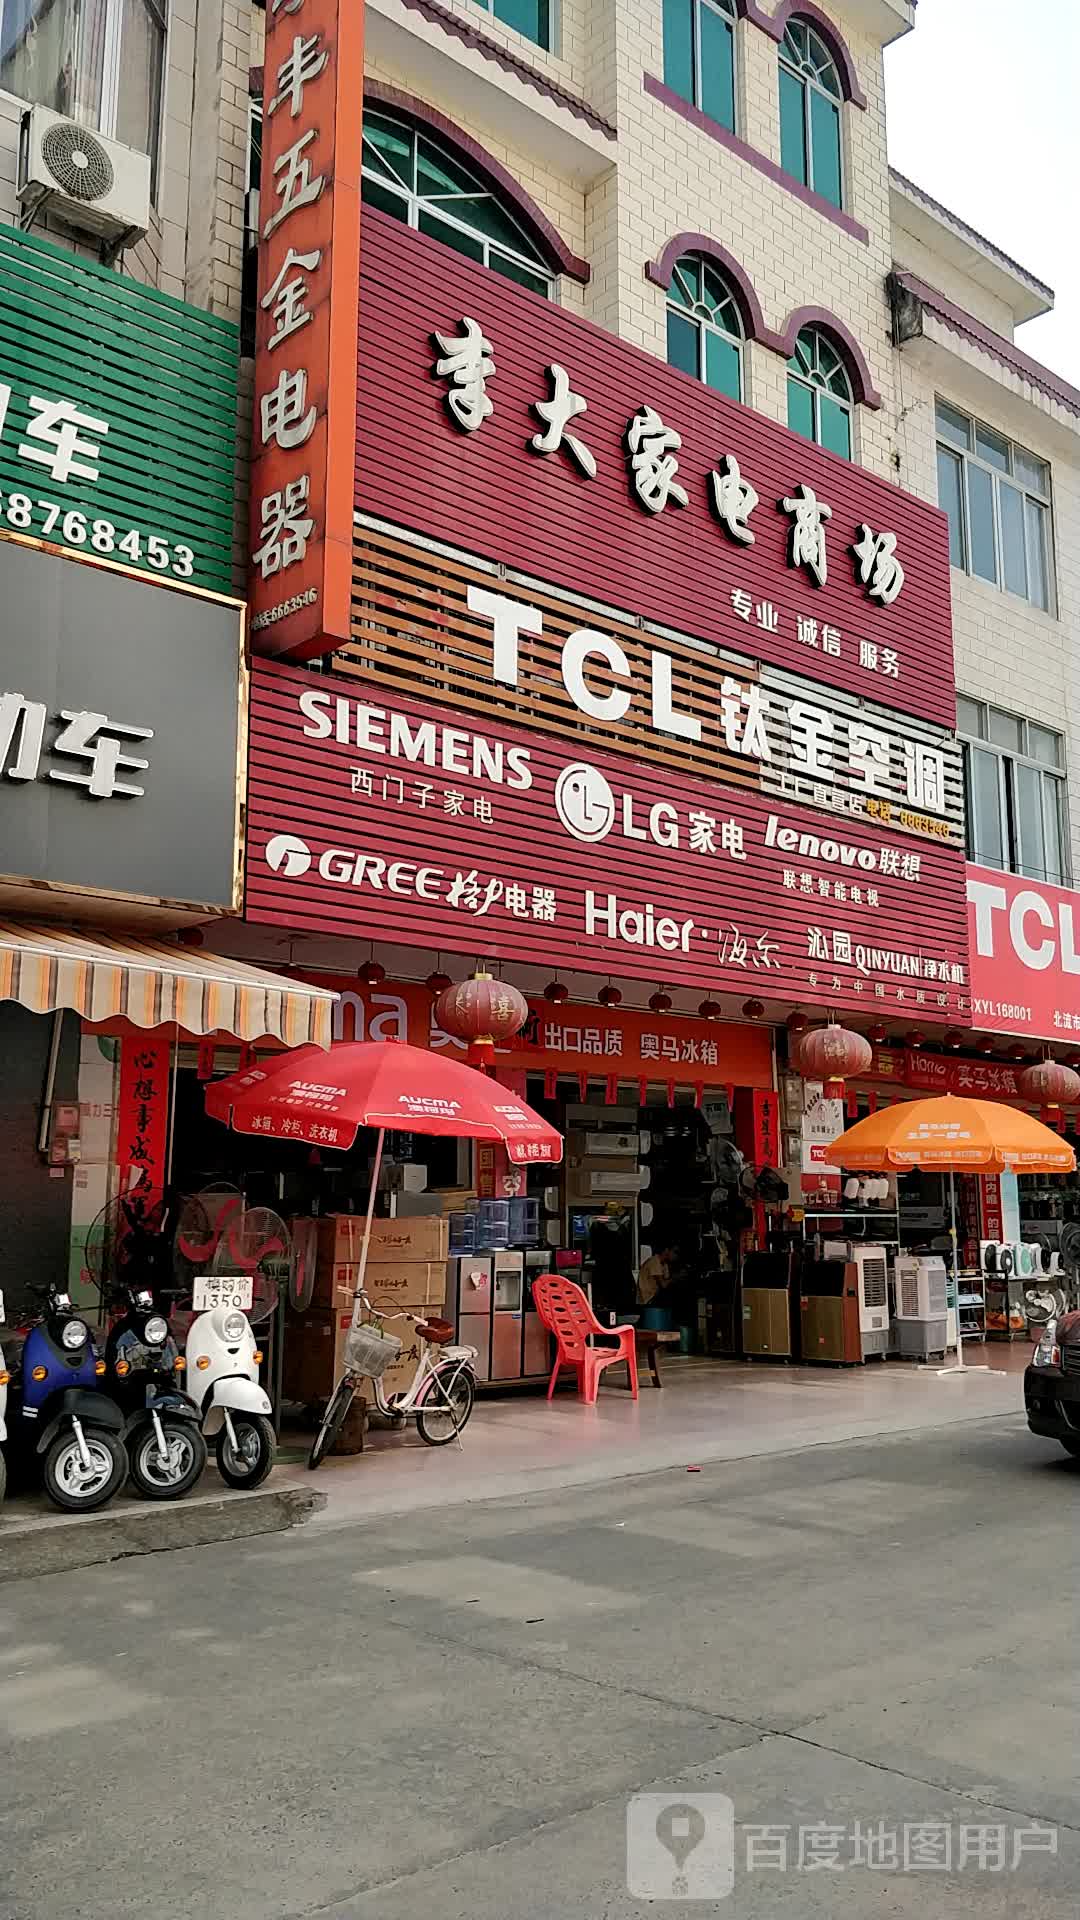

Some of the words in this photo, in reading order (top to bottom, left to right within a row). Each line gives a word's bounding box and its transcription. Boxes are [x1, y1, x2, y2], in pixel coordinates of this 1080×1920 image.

[0, 382, 109, 483] 车
[432, 317, 905, 606] 李大家电商场
[0, 488, 195, 577] 8768453
[730, 588, 779, 634] 专业
[796, 615, 842, 657] 诚信
[859, 639, 900, 679] 服务
[466, 586, 702, 742] TCL
[720, 676, 945, 814] 钛金空调
[299, 690, 534, 791] SIEMENS
[350, 766, 494, 825] 西门子家电
[622, 793, 679, 849] LG
[689, 811, 748, 861] 家电
[764, 814, 876, 870] lenovo
[879, 846, 921, 882] 联想
[318, 849, 444, 900] GREE
[446, 870, 557, 922] 格力电器
[783, 868, 880, 909] 联想智能电视
[585, 890, 694, 953] Haier
[807, 926, 851, 963] 沁园
[855, 944, 920, 976] QINYUAN
[923, 958, 965, 985] 净水机
[966, 879, 1080, 976] TCL
[808, 971, 967, 1012] 专为中国水质设计
[971, 998, 1032, 1022] XYL168001
[544, 1022, 623, 1057] 出口品质
[640, 1033, 718, 1066] 奥马冰箱
[288, 1080, 347, 1097] AUCMA
[398, 1095, 462, 1109] AUCMA
